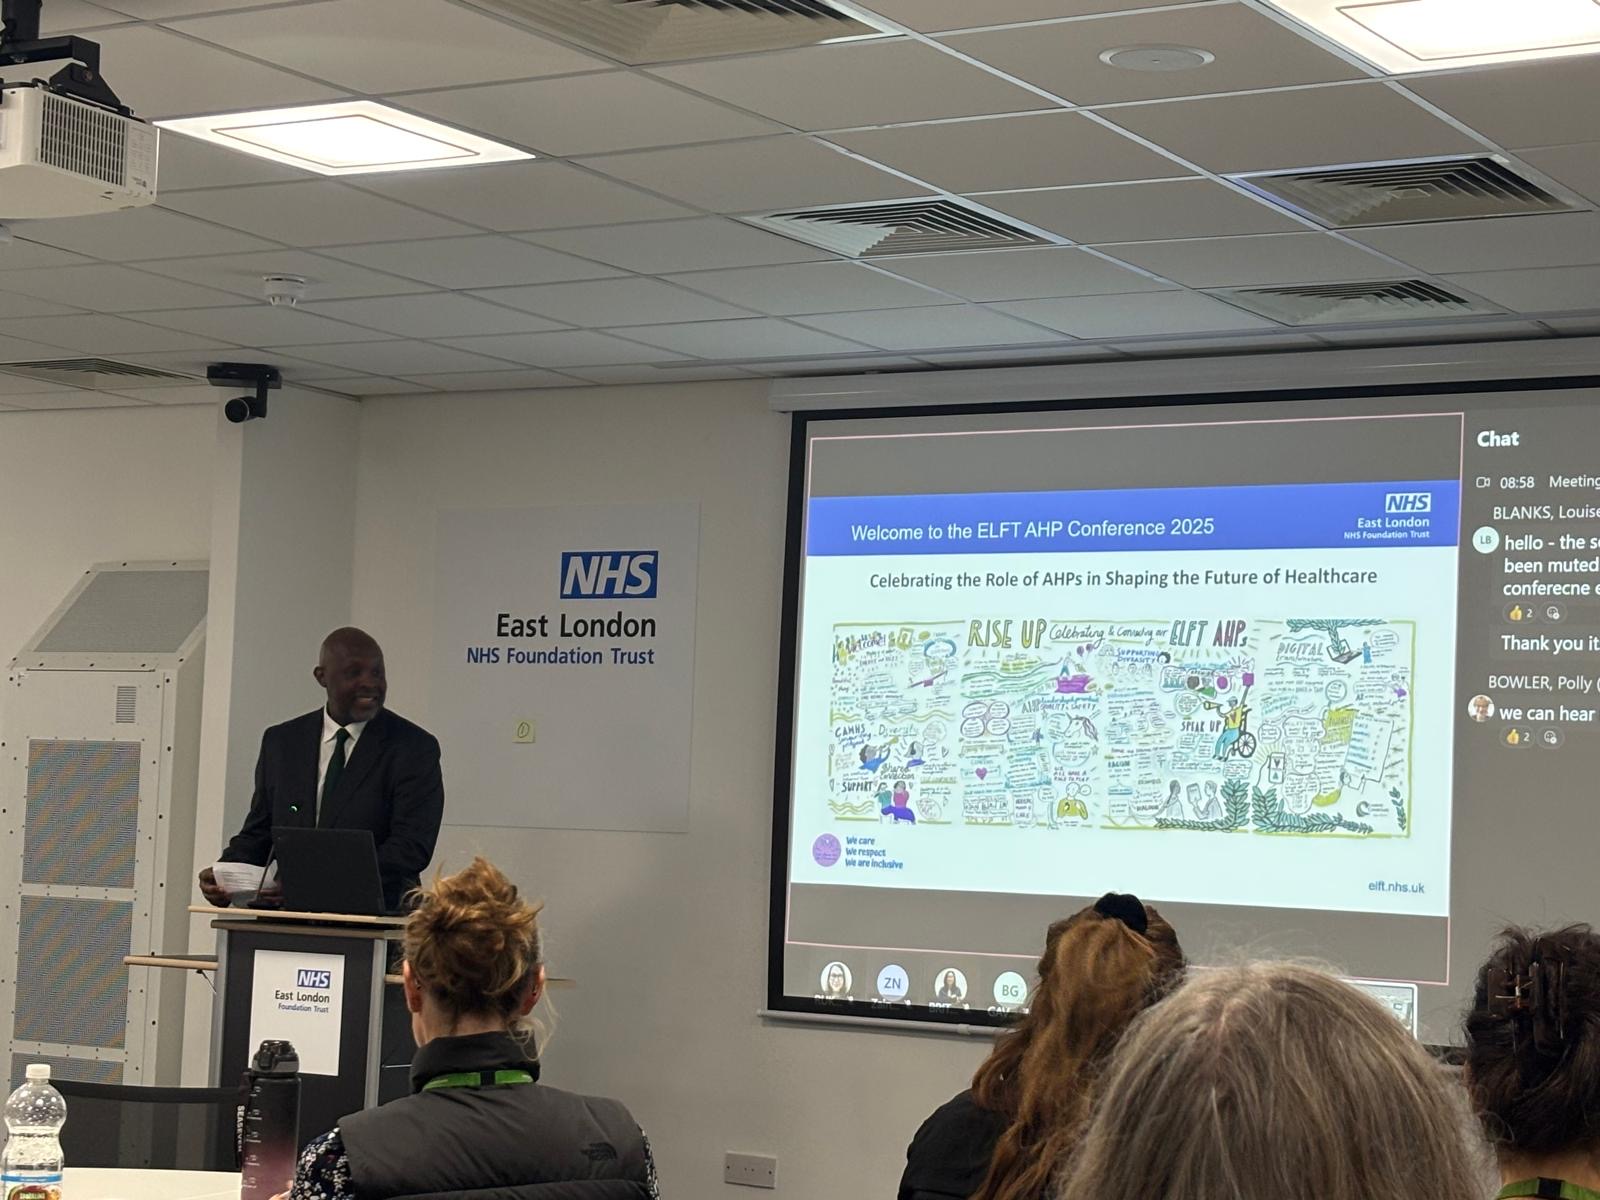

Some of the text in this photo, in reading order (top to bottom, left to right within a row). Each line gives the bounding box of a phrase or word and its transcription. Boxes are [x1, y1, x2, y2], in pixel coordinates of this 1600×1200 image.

[1477, 430, 1520, 447] Chat
[1500, 474, 1600, 490] 08:58 Meeting
[1386, 494, 1430, 512] NHS
[1493, 506, 1554, 520] BLANKS,
[851, 517, 1215, 541] Welcome to the ELFT AHP Conference 2025
[1357, 517, 1430, 529] East London
[1344, 529, 1430, 540] NHS Foundation Trust
[1480, 535, 1492, 545] LB
[1505, 534, 1543, 550] hello
[1560, 533, 1585, 550] the
[1504, 556, 1599, 573] been muted
[562, 553, 656, 597] NHS
[870, 567, 1378, 590] Celebrating the Role of AHPs in Shaping the Future of Healthcare
[1503, 579, 1591, 596] conferecne
[1526, 608, 1533, 618] 2
[497, 611, 656, 638] East London
[968, 619, 1013, 648] RISE
[1021, 618, 1047, 649] UP
[1049, 624, 1105, 650] Celebrating
[1169, 619, 1208, 647] ELFT
[1212, 620, 1249, 648] AHPs
[1278, 642, 1324, 656] DIGITAL
[1501, 634, 1550, 651] Thank
[1553, 638, 1584, 655] you
[467, 646, 655, 665] NHS Foundation Trust
[1488, 675, 1553, 691] BOWLER,
[1558, 675, 1592, 694] Polly
[1500, 705, 1596, 721] we can hear
[834, 723, 866, 738] CAMHS
[1181, 721, 1222, 733] SPEAK UP
[1523, 732, 1530, 742] 2
[846, 835, 857, 845] We
[846, 847, 886, 858] We respect
[845, 858, 856, 867] We
[871, 858, 903, 869] inclusive
[1368, 880, 1425, 893] elft.nhs.uk
[297, 969, 331, 988] NHS
[884, 977, 901, 989] ZN
[275, 990, 330, 1003] East London
[1002, 984, 1019, 997] BG
[278, 1003, 329, 1014] Foundation Trust
